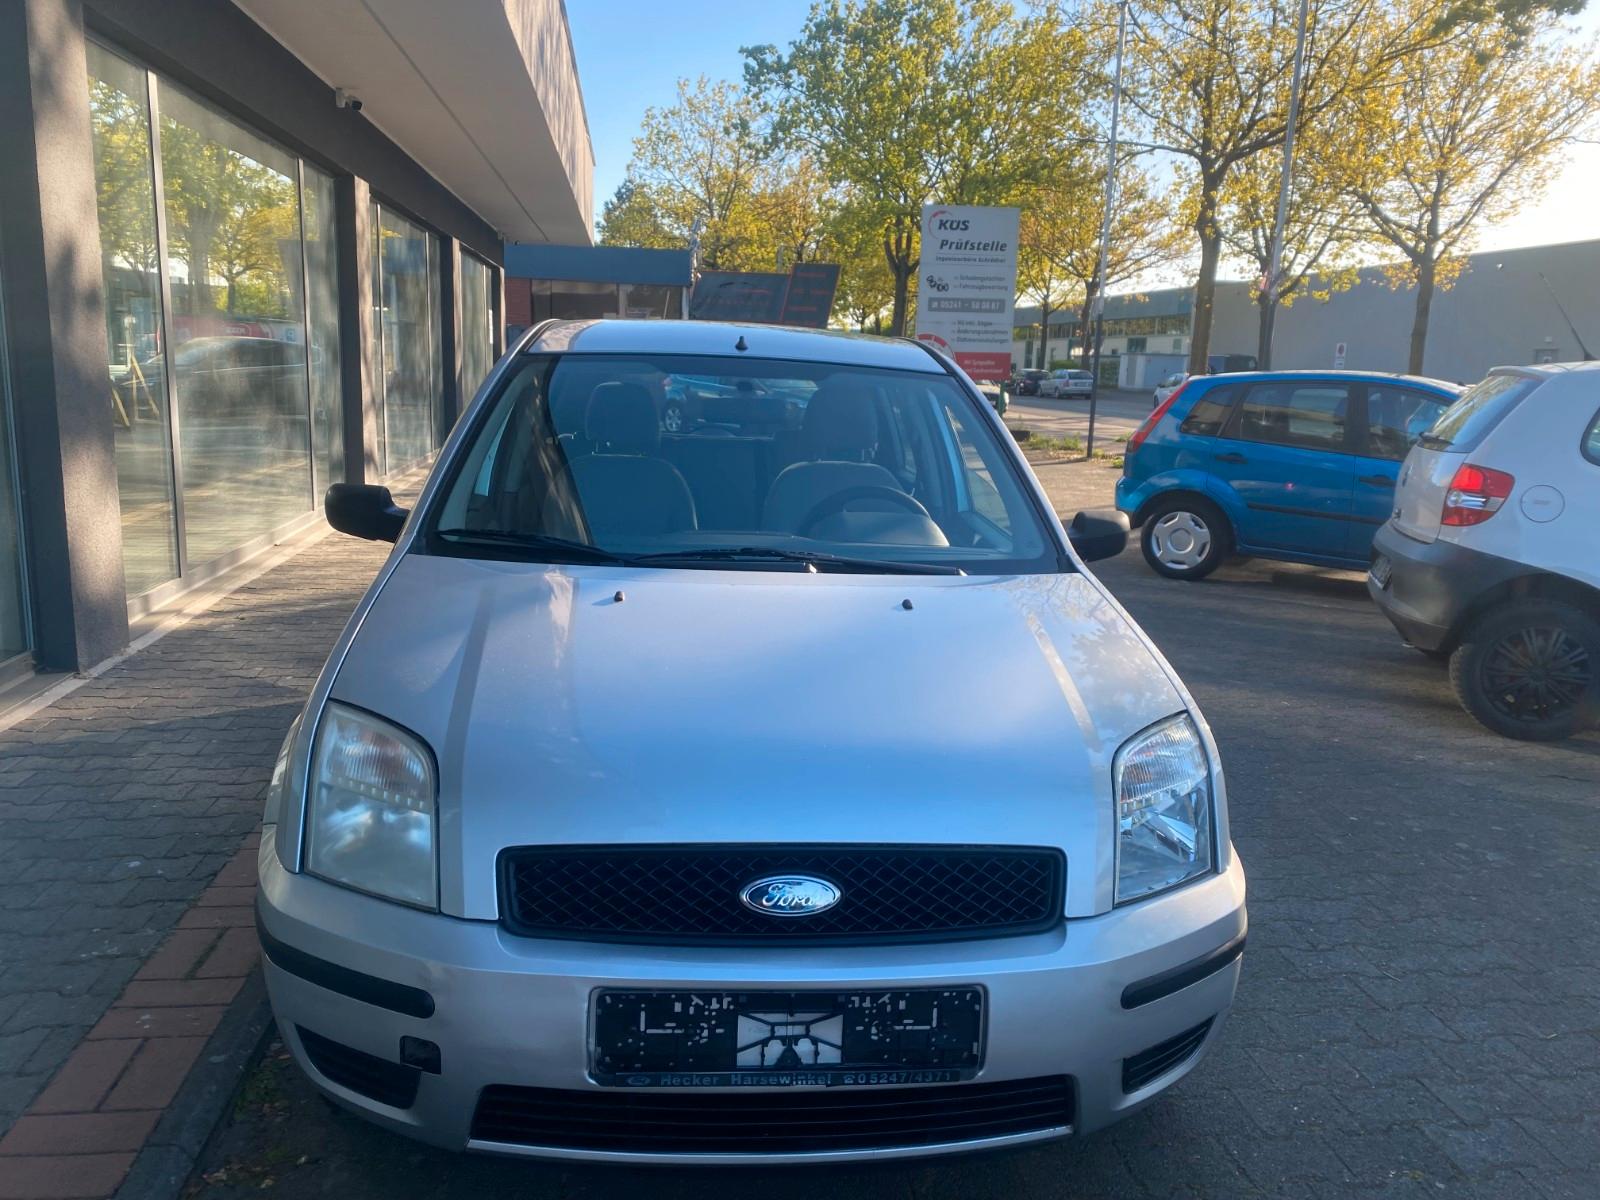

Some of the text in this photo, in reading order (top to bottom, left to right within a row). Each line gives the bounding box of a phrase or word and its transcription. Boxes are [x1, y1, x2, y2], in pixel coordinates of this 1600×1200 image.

[938, 219, 970, 231] KÜS
[939, 238, 1008, 252] Prüfstelle
[762, 882, 818, 907] Ford
[661, 1074, 719, 1086] Hecker
[731, 1073, 831, 1086] Harsewinkel
